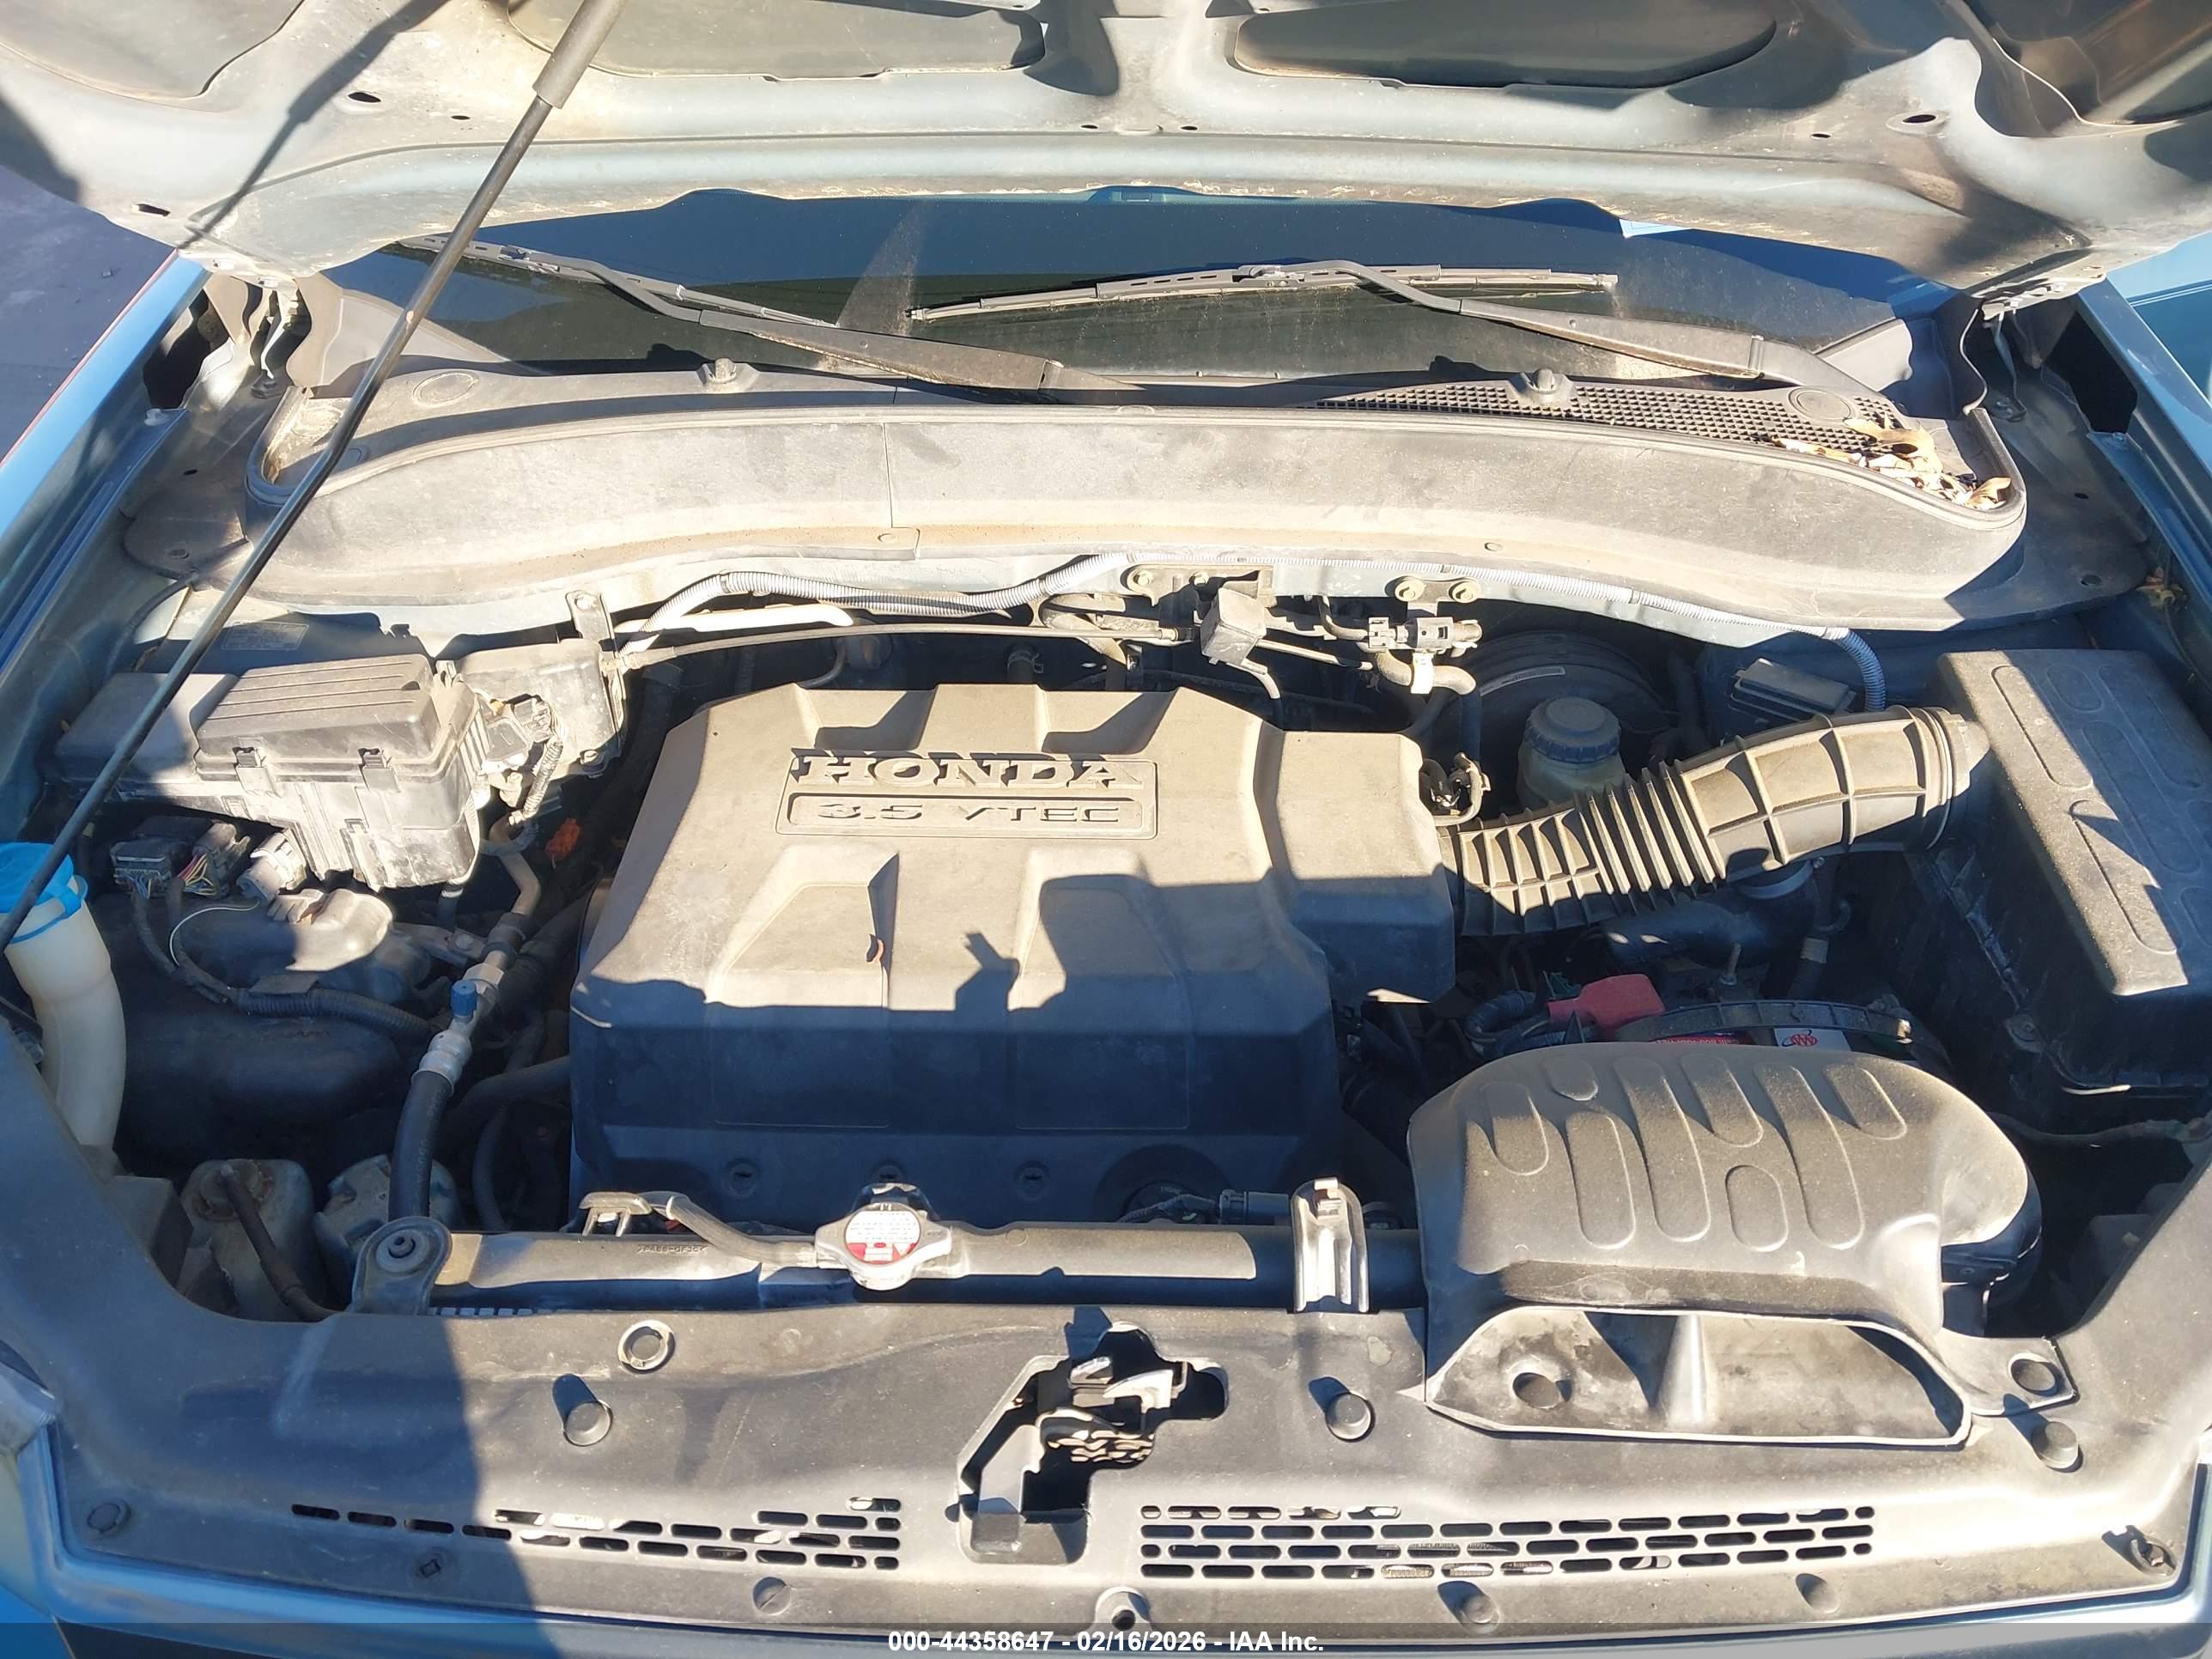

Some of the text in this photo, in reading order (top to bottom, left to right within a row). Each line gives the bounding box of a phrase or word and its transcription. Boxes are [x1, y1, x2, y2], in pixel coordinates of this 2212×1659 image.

[795, 752, 1144, 788] HONDA
[817, 804, 1120, 823] 3.5 VTEC
